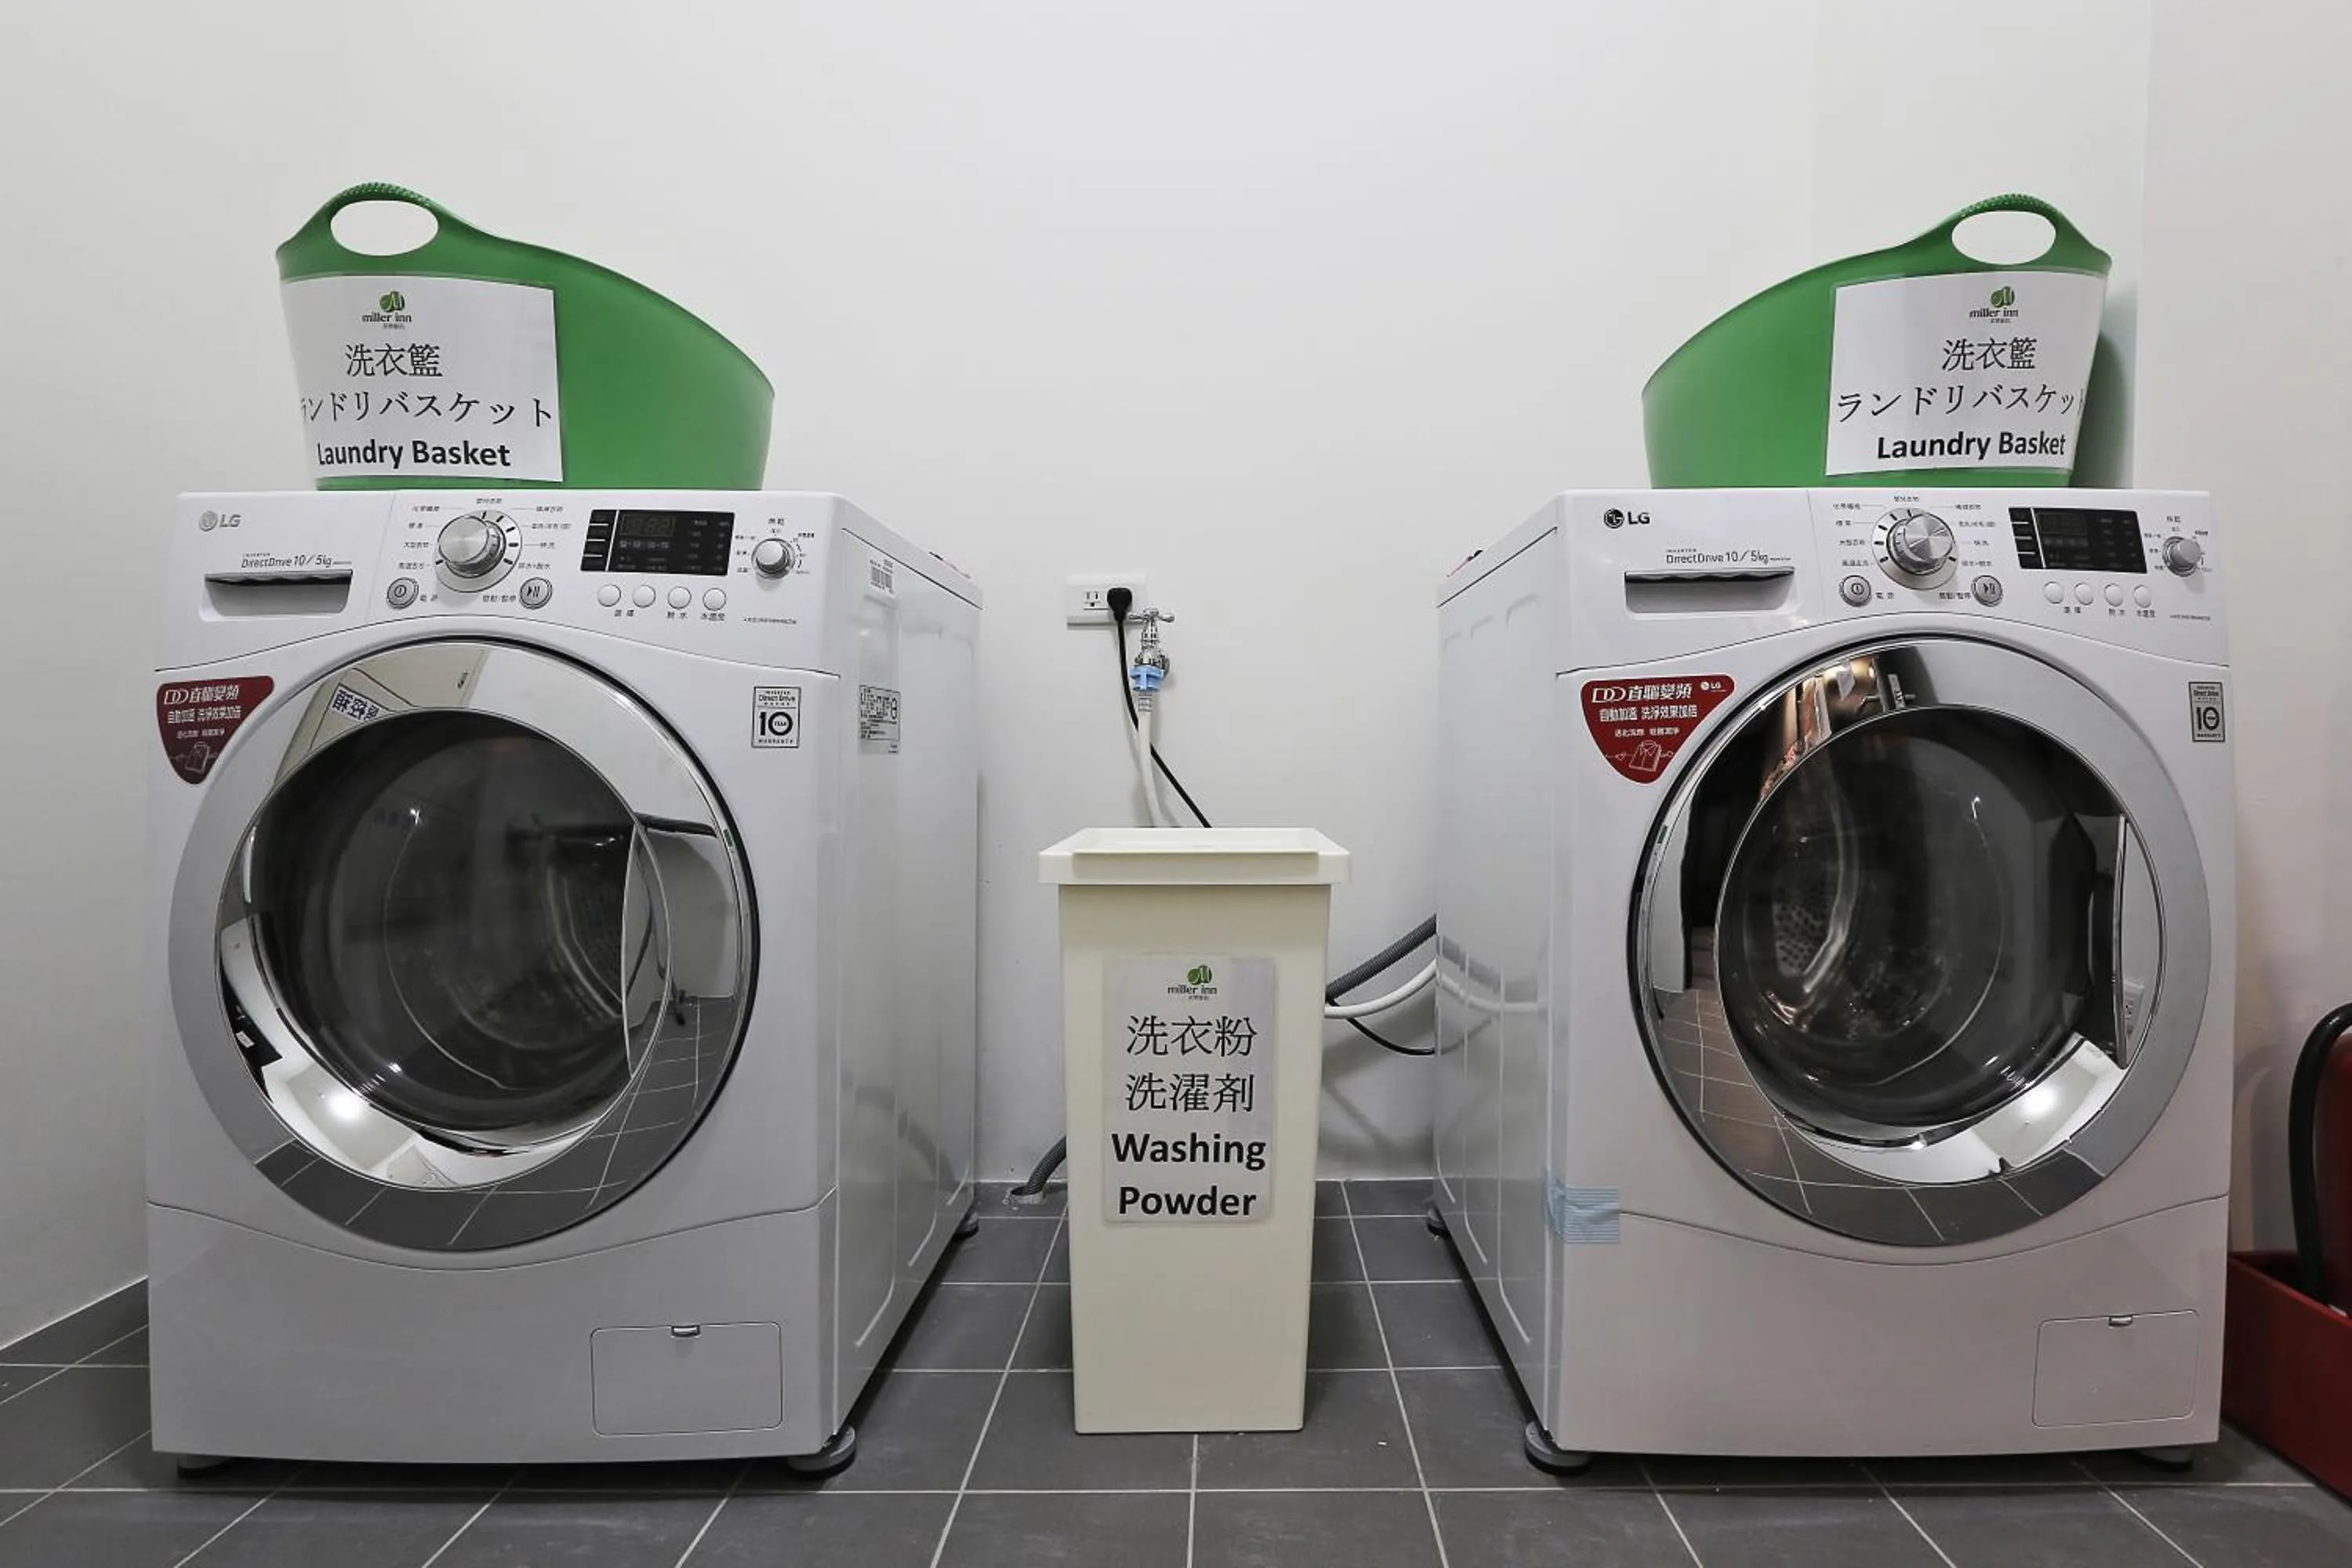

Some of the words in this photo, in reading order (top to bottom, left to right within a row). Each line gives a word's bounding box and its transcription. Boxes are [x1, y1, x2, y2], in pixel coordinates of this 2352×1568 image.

[362, 311, 392, 322] miller
[394, 312, 412, 322] inn
[1969, 308, 2000, 318] miller
[2003, 307, 2019, 318] inn
[344, 343, 443, 376] 洗衣籃
[1941, 336, 2038, 371] 洗衣籃
[318, 439, 403, 470] Laundry
[412, 440, 511, 466] Basket
[1878, 431, 1991, 459] Laundry
[1999, 431, 2066, 456] Basket
[219, 514, 241, 528] LG
[1628, 512, 1650, 524] LG
[759, 711, 794, 736] 10
[1167, 985, 1199, 994] miller
[1200, 985, 1217, 994] inn
[1126, 1015, 1257, 1057] 洗衣粉
[1125, 1073, 1255, 1113] 洗濯剤
[1112, 1132, 1266, 1171] Washing
[1119, 1185, 1256, 1216] Powder
